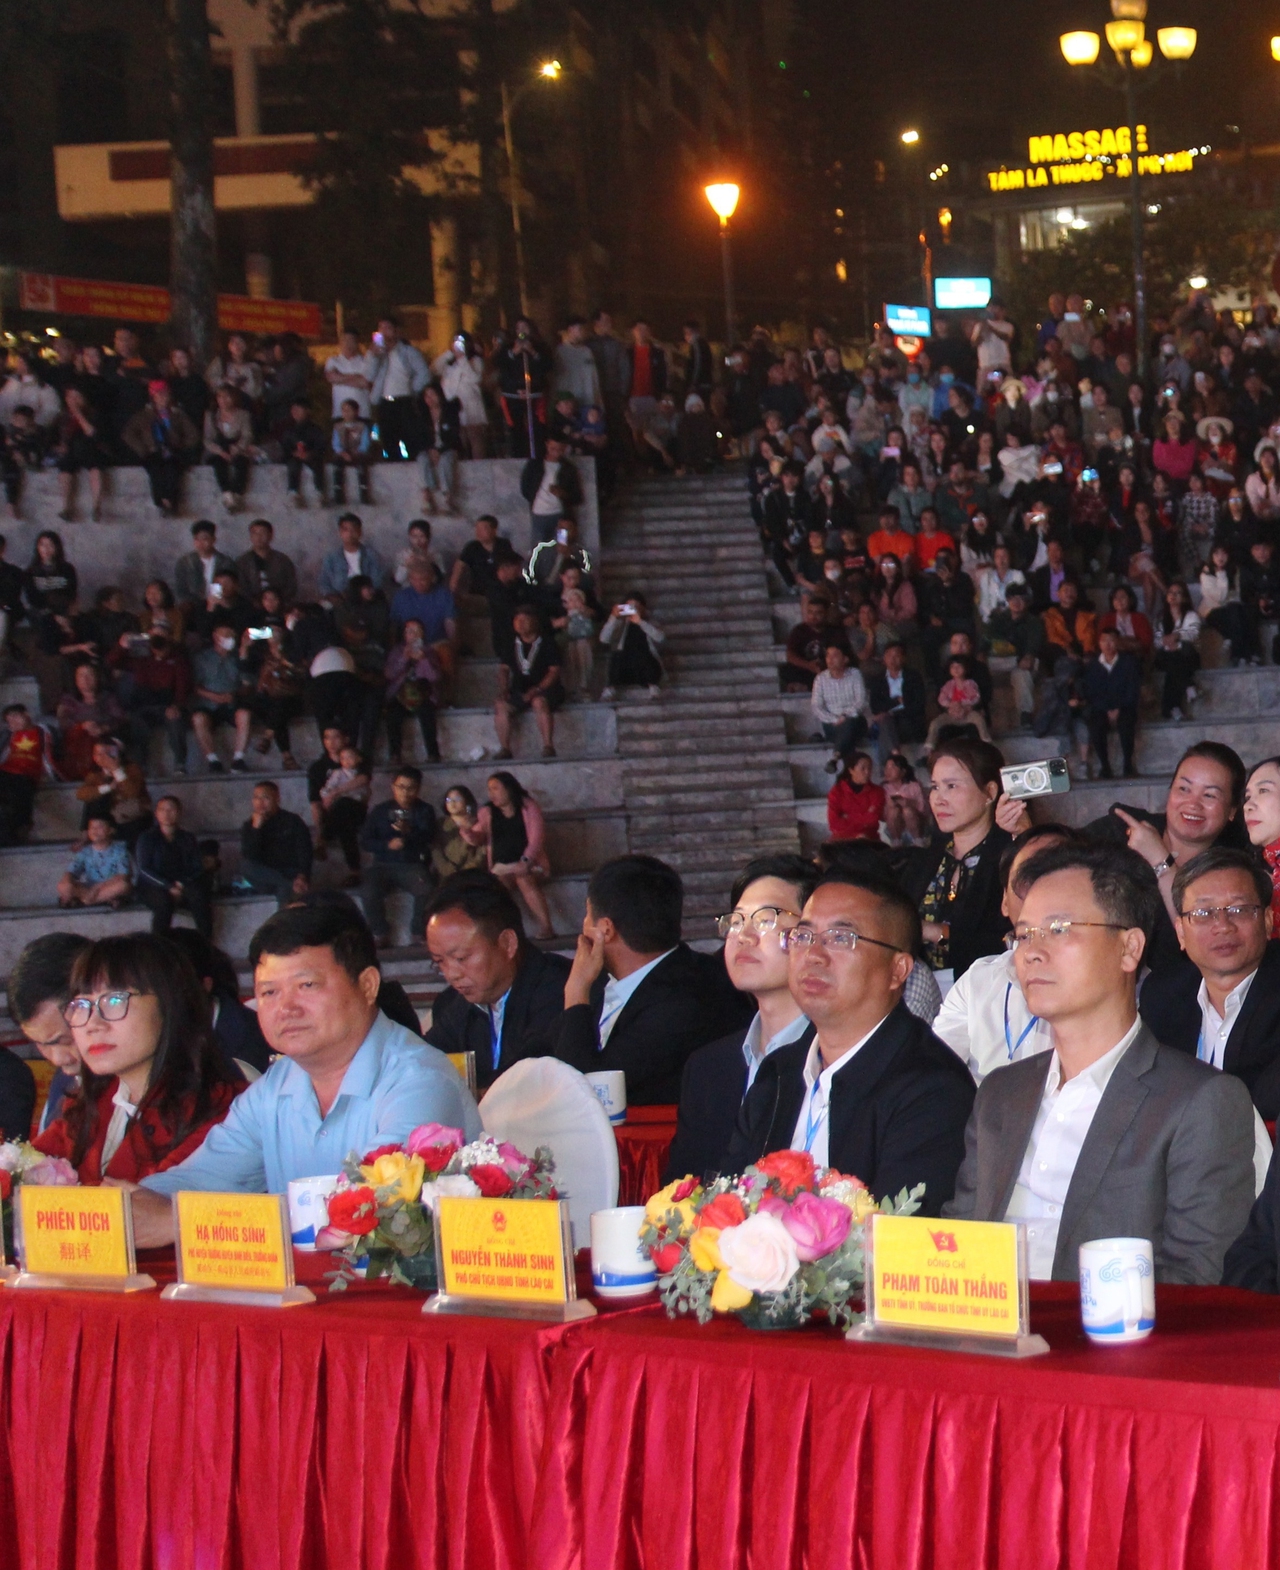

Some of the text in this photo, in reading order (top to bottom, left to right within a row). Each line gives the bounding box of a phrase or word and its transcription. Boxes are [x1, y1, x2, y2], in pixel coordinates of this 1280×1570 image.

[37, 1207, 110, 1236] PHIÊN DỊCH
[242, 1226, 266, 1244] SINH
[494, 1249, 528, 1269] THÀNH
[530, 1254, 555, 1271] SINH
[882, 1272, 1008, 1300] PHẠM TOÀN THẮNG
